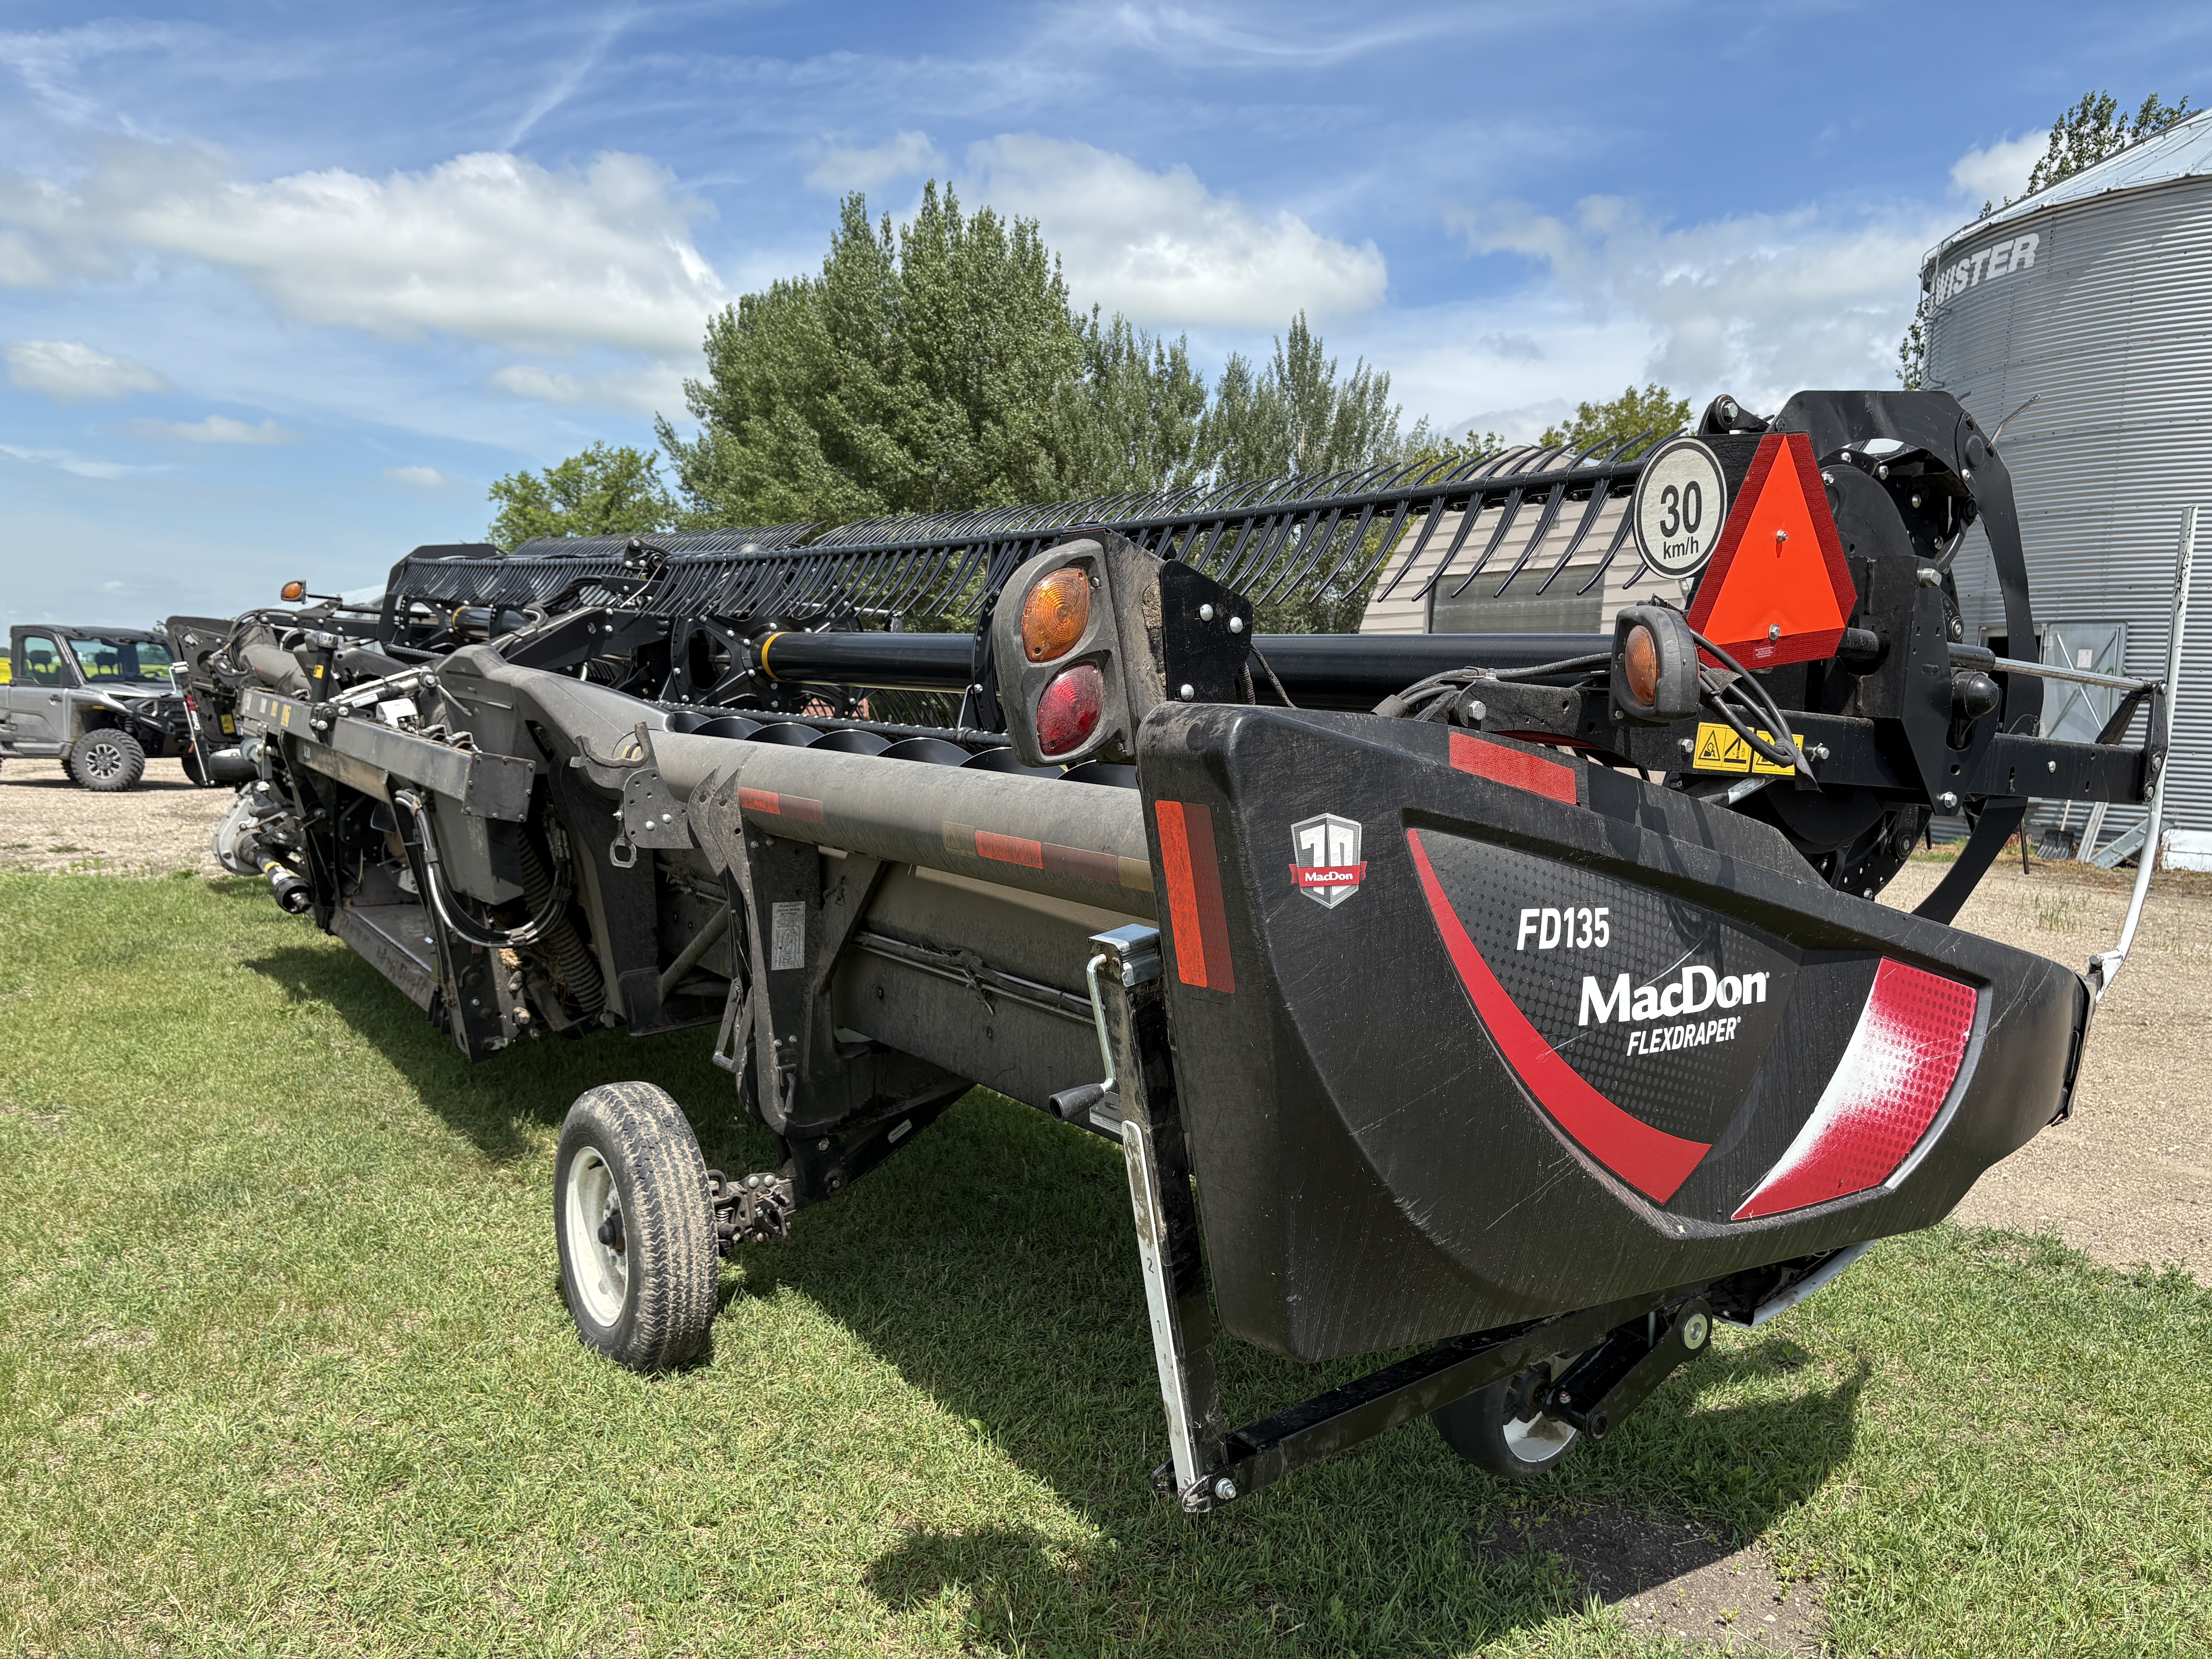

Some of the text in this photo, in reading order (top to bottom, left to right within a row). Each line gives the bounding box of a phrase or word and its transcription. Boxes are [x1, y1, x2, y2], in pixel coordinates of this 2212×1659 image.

[1660, 481, 1702, 538] 30
[1663, 536, 1699, 560] km/h
[1305, 871, 1353, 882] MacDon
[1516, 907, 1609, 950] FD135
[1147, 1257, 1154, 1274] 2
